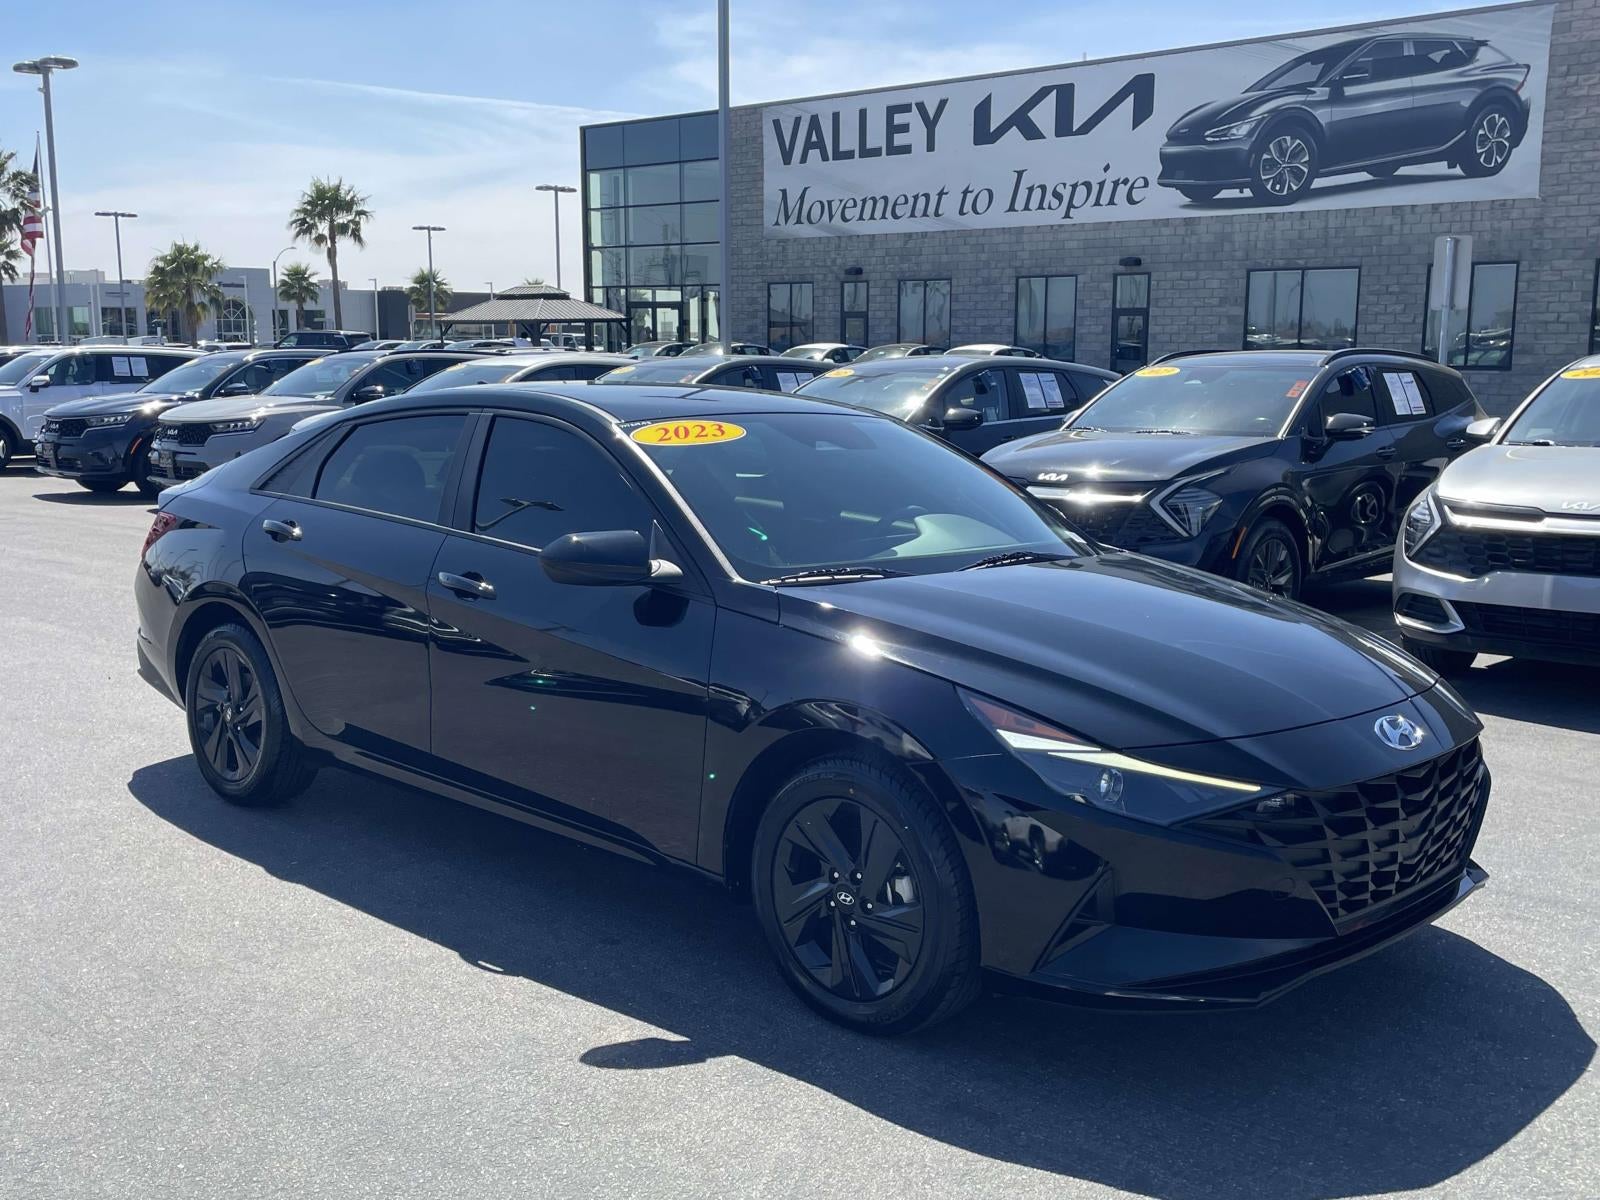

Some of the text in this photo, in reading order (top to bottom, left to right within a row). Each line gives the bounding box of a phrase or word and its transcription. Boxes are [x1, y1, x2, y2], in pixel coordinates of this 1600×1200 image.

[772, 73, 1155, 166] VALLEY KIA
[772, 163, 1149, 226] Movement to Inspire
[655, 423, 725, 442] 2023
